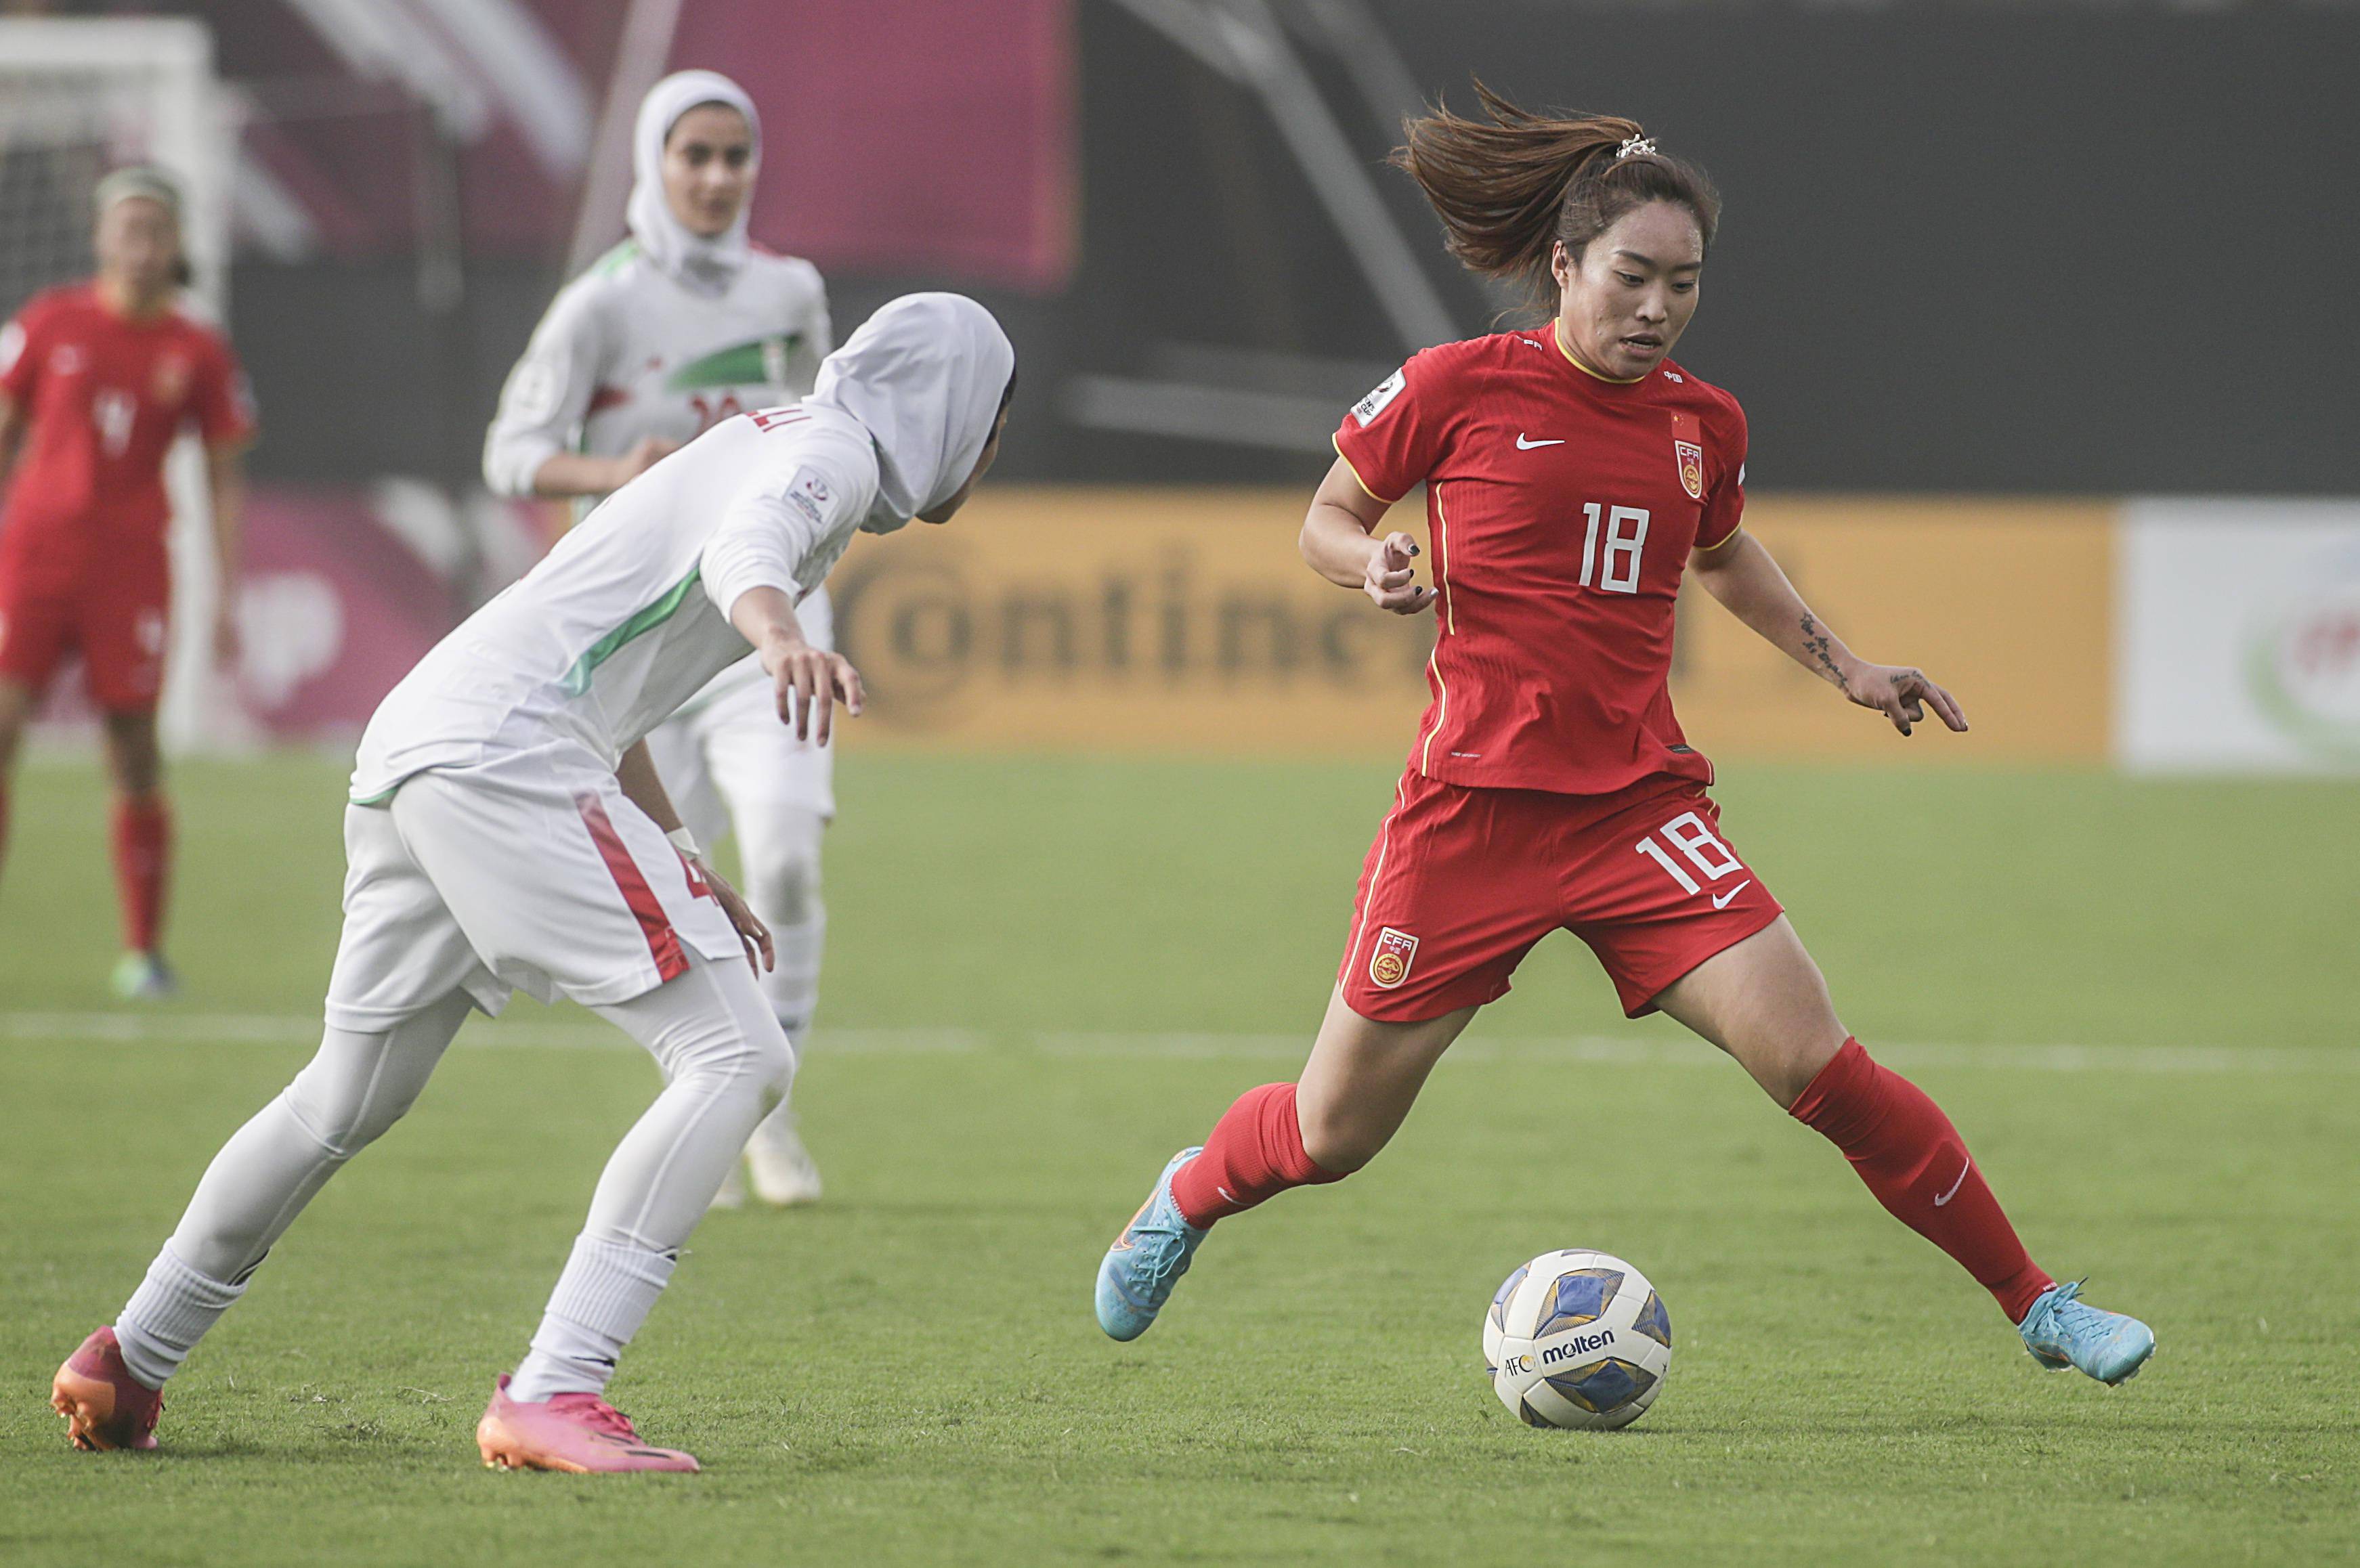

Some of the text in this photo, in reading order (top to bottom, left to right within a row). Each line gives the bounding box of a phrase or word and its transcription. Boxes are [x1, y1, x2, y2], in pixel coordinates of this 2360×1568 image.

[1679, 446, 1699, 460] CFA
[1579, 502, 1650, 594] 18
[1635, 811, 1743, 896] 18
[1383, 933, 1413, 951] CFA
[1543, 1330, 1615, 1364] molten
[1504, 1354, 1536, 1378] AFC
